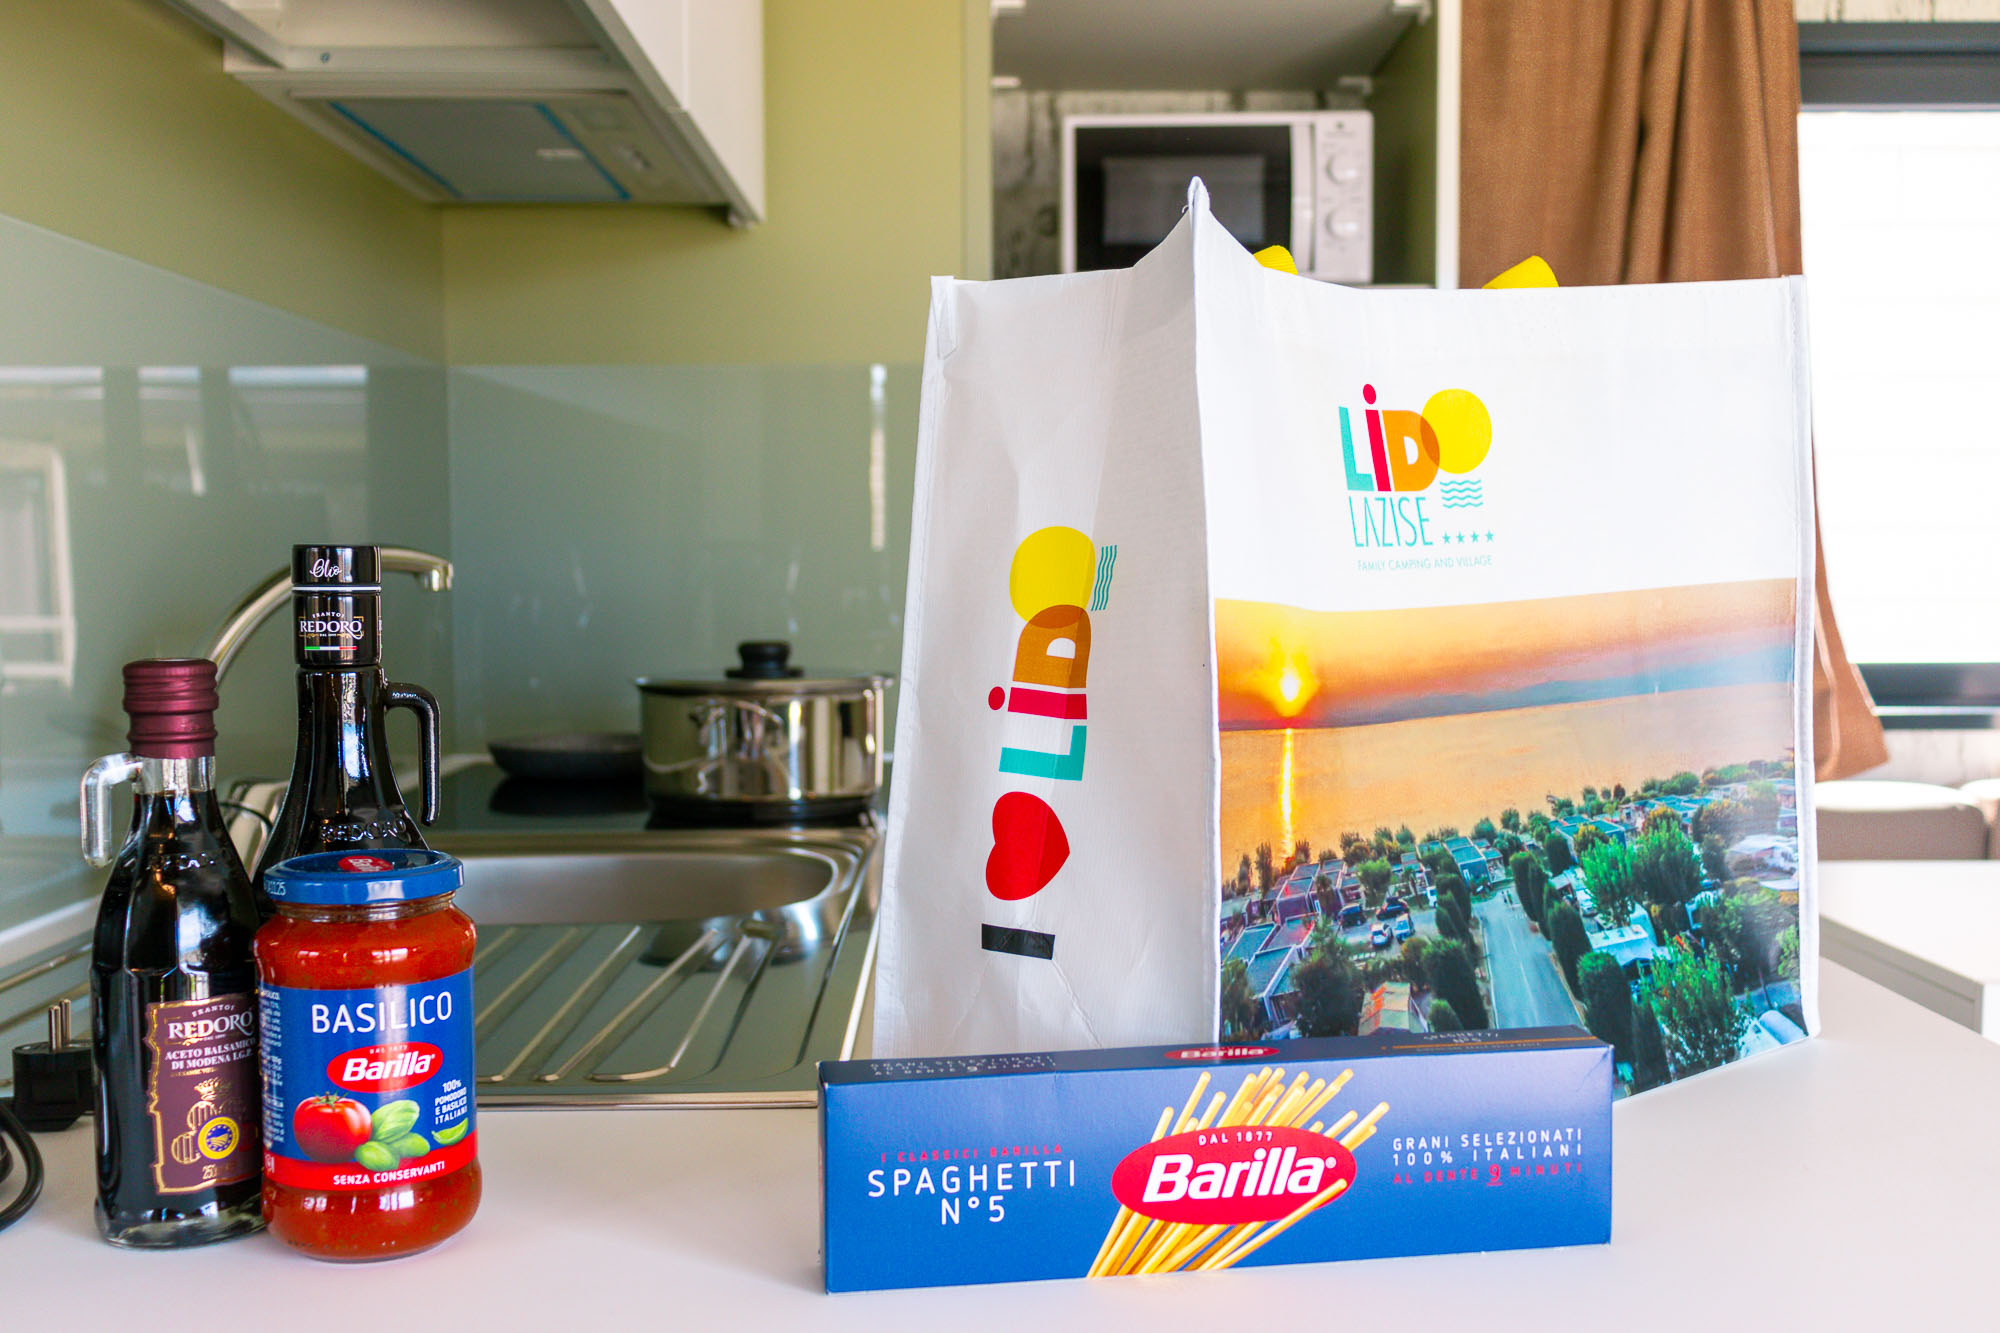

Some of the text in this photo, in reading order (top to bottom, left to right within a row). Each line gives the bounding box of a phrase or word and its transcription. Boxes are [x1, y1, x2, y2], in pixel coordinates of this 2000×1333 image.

[1348, 496, 1433, 548] LAZISE
[1357, 554, 1493, 571] FAMILY CAMPING AND VILLAGE
[299, 620, 364, 640] REDORO
[311, 991, 452, 1034] BASILICO
[168, 1009, 254, 1040] REDORO
[164, 1036, 256, 1061] ACETO BALSAMICO
[1181, 1048, 1264, 1058] Barilla
[171, 1059, 184, 1071] DI
[186, 1054, 231, 1070] MODENA
[342, 1051, 431, 1082] Barilla
[434, 1087, 467, 1106] POMODORO
[442, 1079, 461, 1093] 100%
[435, 1096, 467, 1116] E BASILICO
[435, 1105, 468, 1125] ITALIANI
[1198, 1130, 1273, 1146] DAL 1877
[1393, 1128, 1582, 1151] GRANI SELEZIONATI
[898, 1148, 978, 1163] CLASSICI
[990, 1144, 1062, 1158] BARILLA
[1393, 1143, 1582, 1167] 100% ITALIANI
[333, 1161, 445, 1185] SENZA CONSERVANTI
[868, 1159, 1075, 1198] SPAGHETTI
[1142, 1146, 1325, 1203] Barilla
[1393, 1162, 1582, 1184] AL DENTE 9 MINUTI
